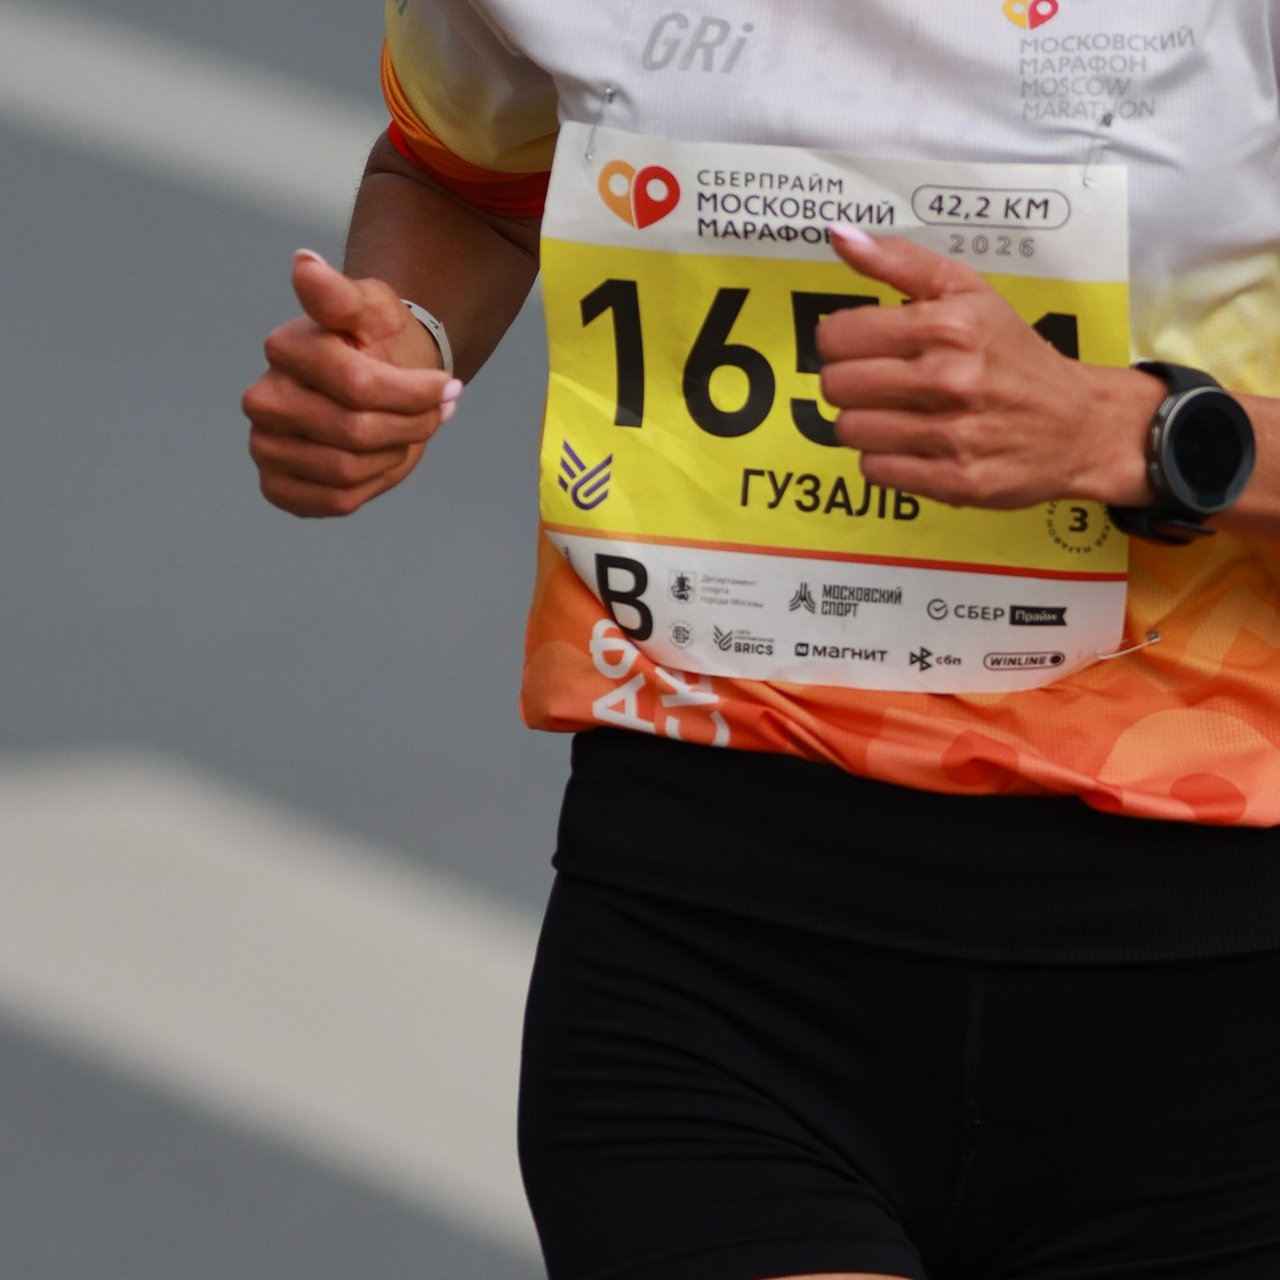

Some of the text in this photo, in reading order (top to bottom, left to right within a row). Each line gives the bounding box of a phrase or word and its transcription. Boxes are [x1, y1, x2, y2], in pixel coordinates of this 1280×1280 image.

[641, 12, 755, 74] GRi
[1020, 25, 1196, 54] МОСКОВСКИЙ
[1020, 55, 1147, 75] МАРАФОН
[1021, 76, 1132, 98] MOSCOW
[697, 169, 844, 195] СБЕРПРАЙМ
[697, 192, 895, 226] МОСКОВСКИЙ
[929, 194, 1050, 221] 42,2 КМ
[948, 233, 1036, 258] 2026
[1068, 506, 1088, 533] 3
[822, 584, 902, 605] МОСКОВСКИЙ
[821, 601, 859, 618] СПОРТ
[953, 604, 1005, 621] СБЕР
[734, 642, 774, 656] BRICS
[812, 645, 888, 663] магнит
[936, 653, 962, 666] сбп
[990, 651, 1047, 666] WINLINE
